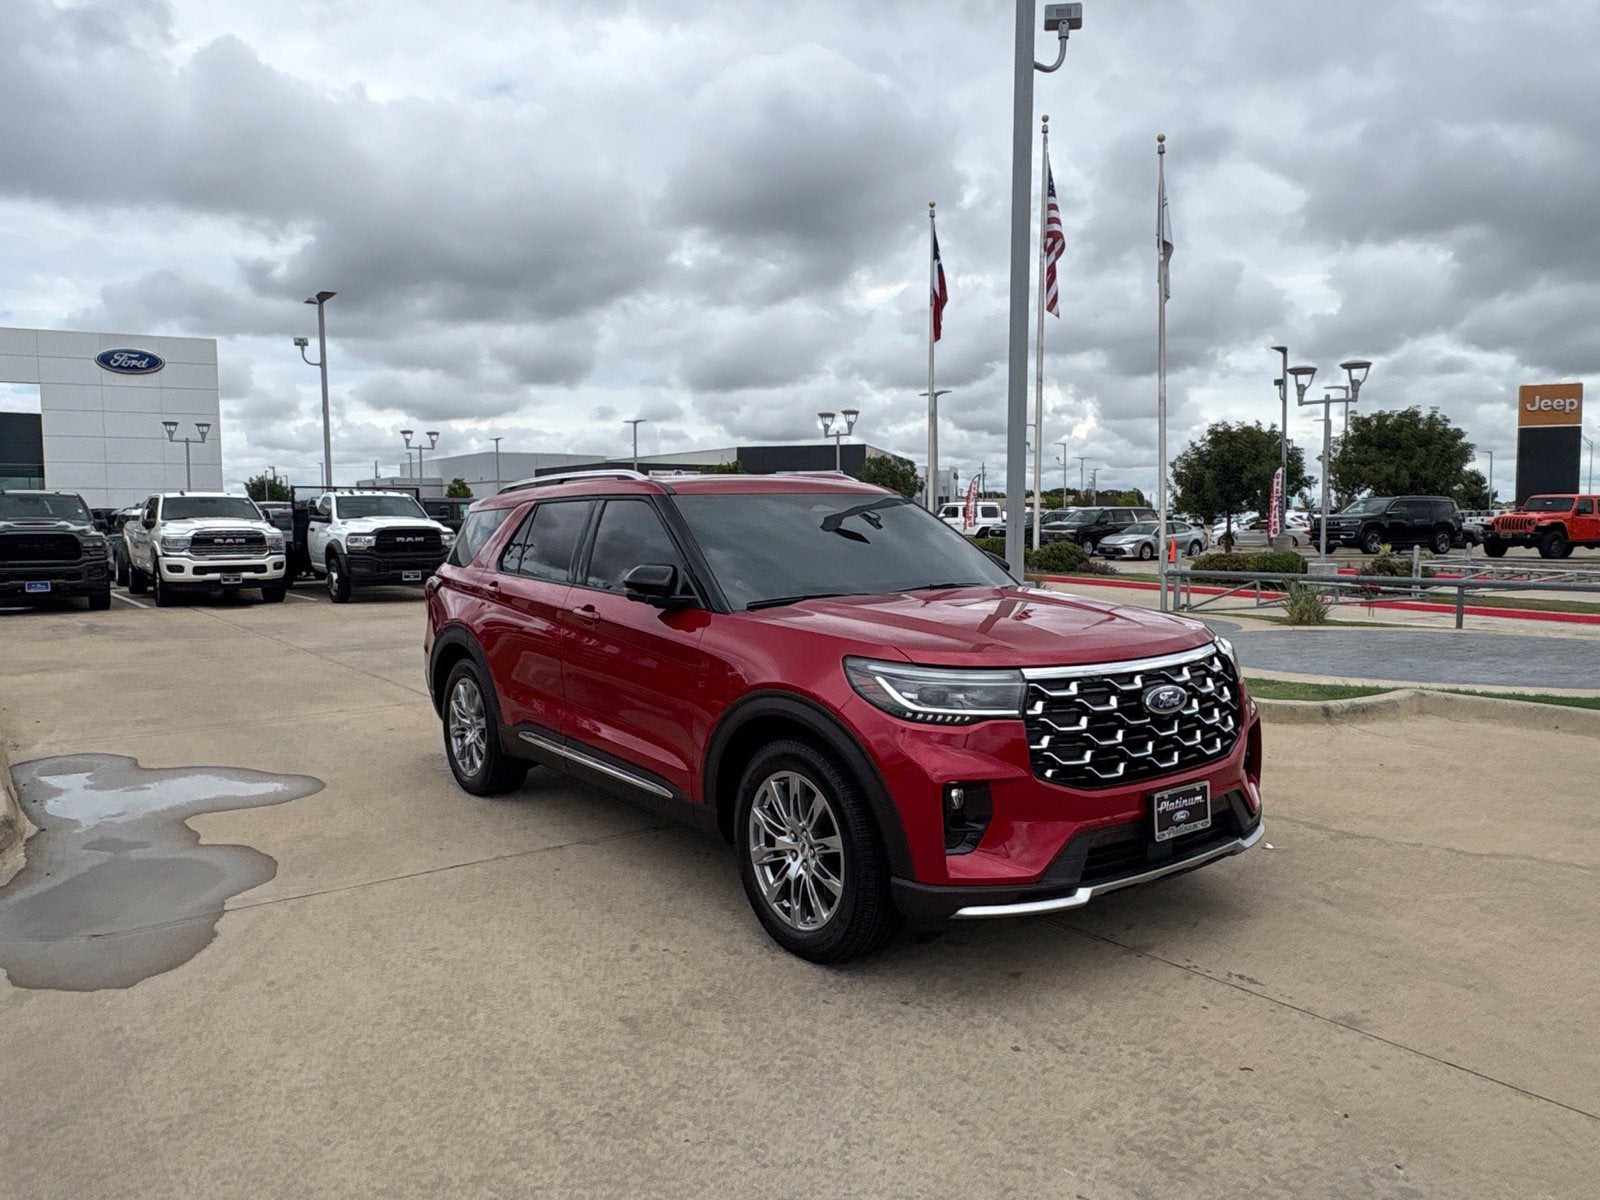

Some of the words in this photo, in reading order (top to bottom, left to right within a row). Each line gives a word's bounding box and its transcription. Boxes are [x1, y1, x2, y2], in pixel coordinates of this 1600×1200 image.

[110, 352, 149, 368] Ford
[1526, 395, 1578, 413] Jeep
[1158, 691, 1181, 708] Ford
[1157, 795, 1205, 813] Platinum
